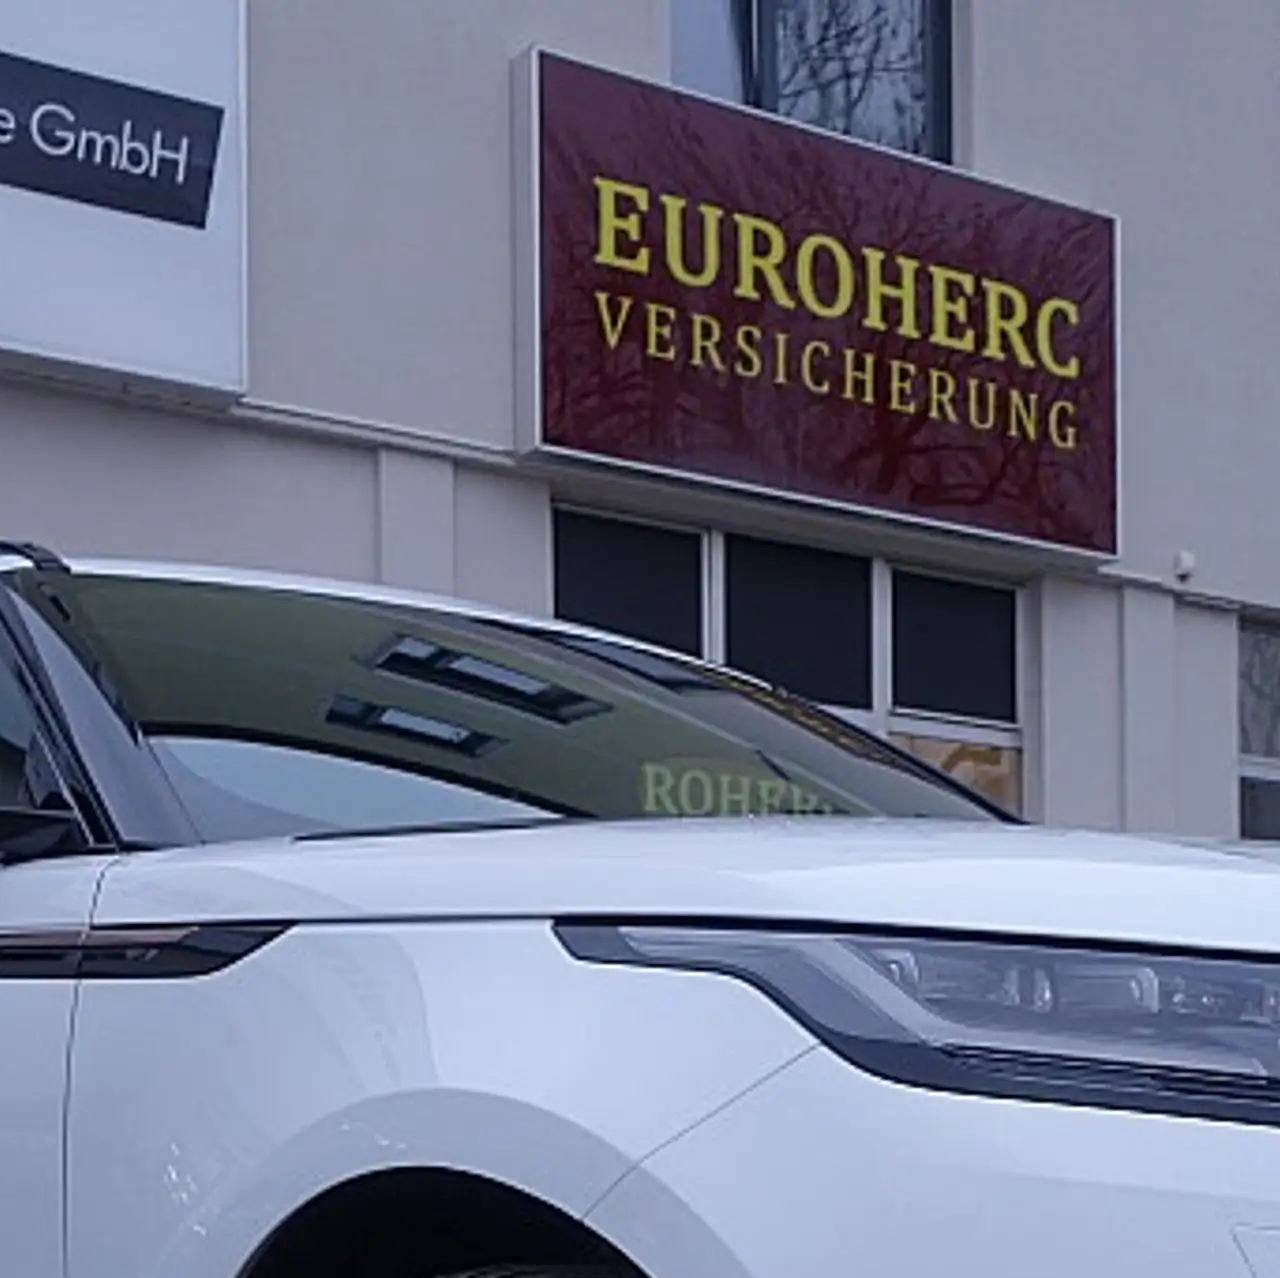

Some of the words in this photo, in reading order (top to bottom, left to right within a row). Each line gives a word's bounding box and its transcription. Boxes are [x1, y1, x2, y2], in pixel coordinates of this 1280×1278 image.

[29, 102, 189, 185] GmbH
[592, 176, 1081, 379] EUROHERC
[595, 291, 1077, 450] VERSICHERUNG
